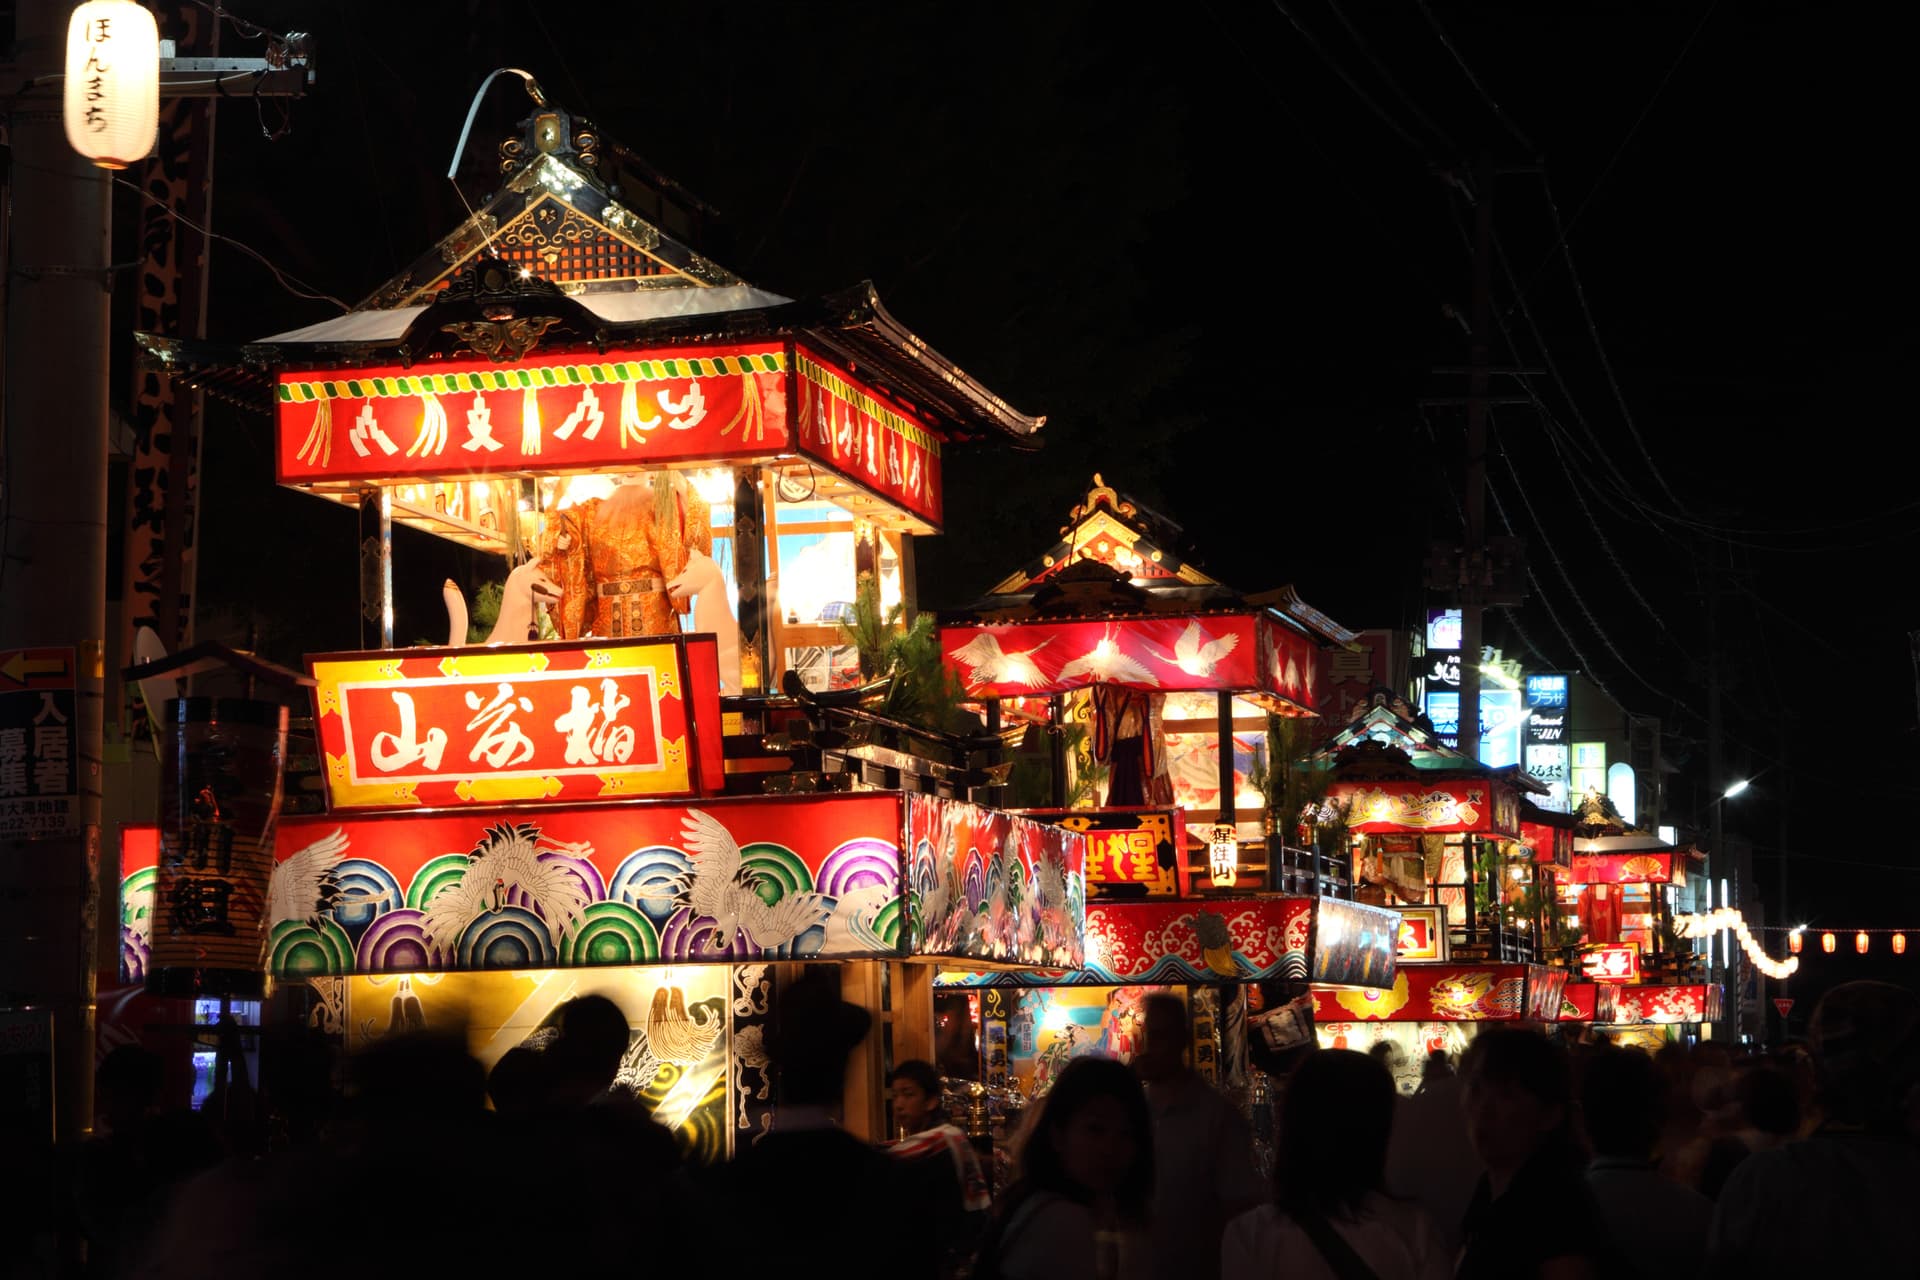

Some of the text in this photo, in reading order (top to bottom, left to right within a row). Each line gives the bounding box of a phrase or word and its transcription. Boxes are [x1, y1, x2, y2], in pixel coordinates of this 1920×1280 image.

[83, 17, 112, 135] ほんまち
[1528, 691, 1565, 705] プラザ
[0, 726, 28, 798] 募集
[32, 691, 70, 796] 入居者
